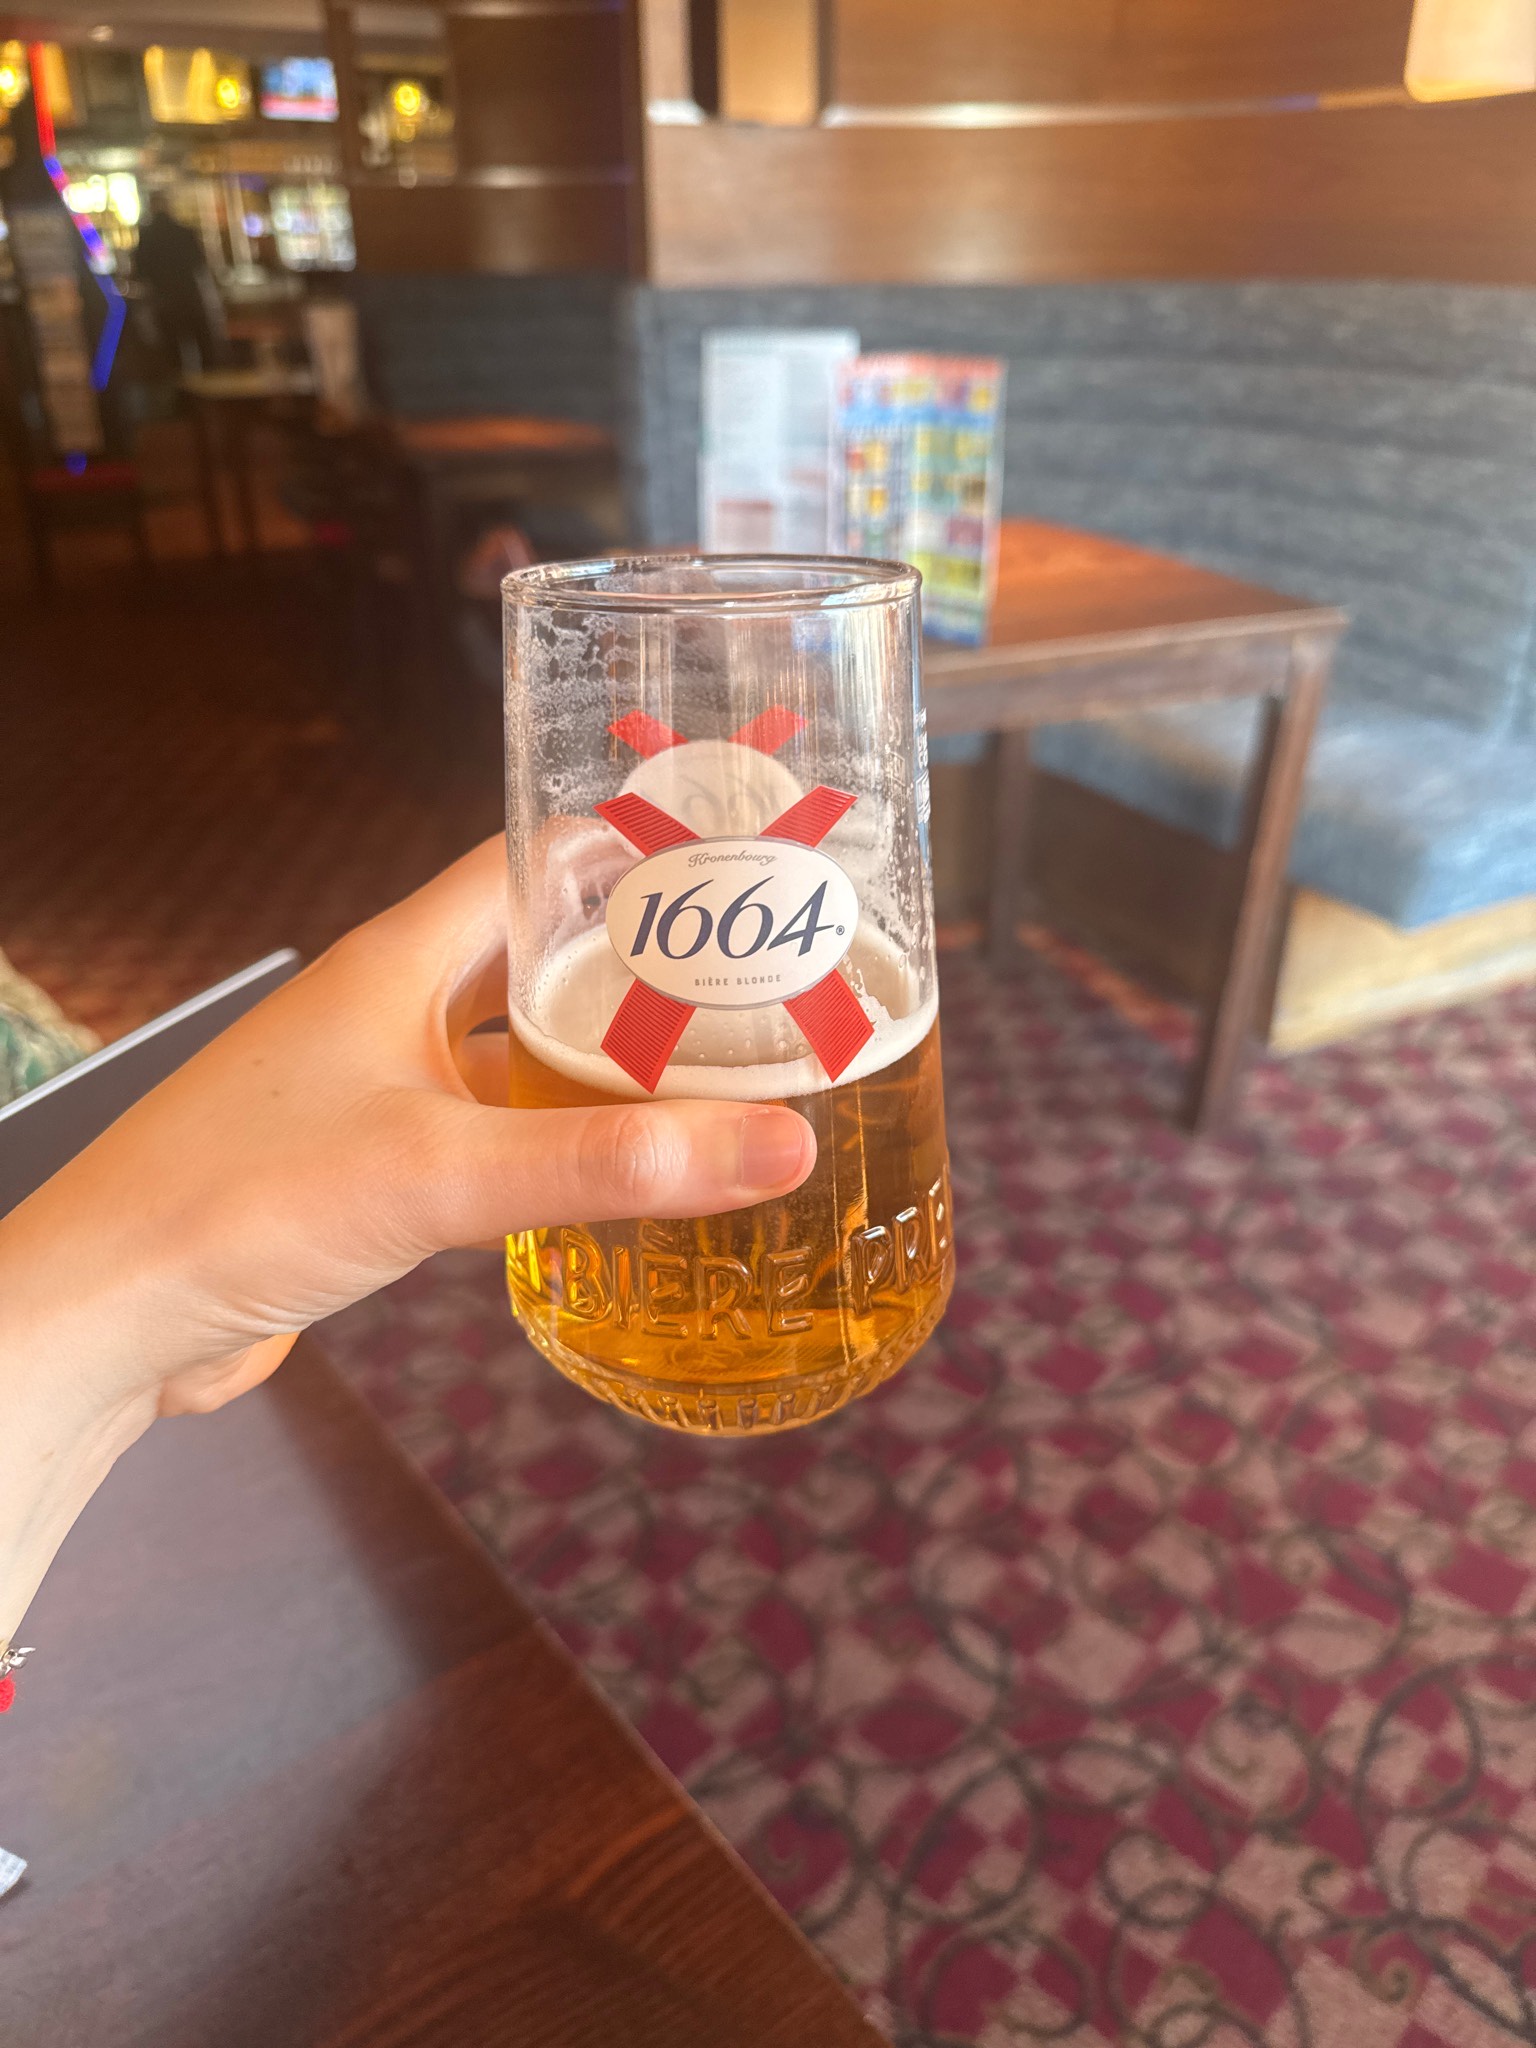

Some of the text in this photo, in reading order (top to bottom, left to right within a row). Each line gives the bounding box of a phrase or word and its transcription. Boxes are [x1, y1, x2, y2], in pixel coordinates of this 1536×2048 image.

[688, 850, 777, 868] Kronenbourg
[694, 974, 782, 987] BIÈRE BLONDE
